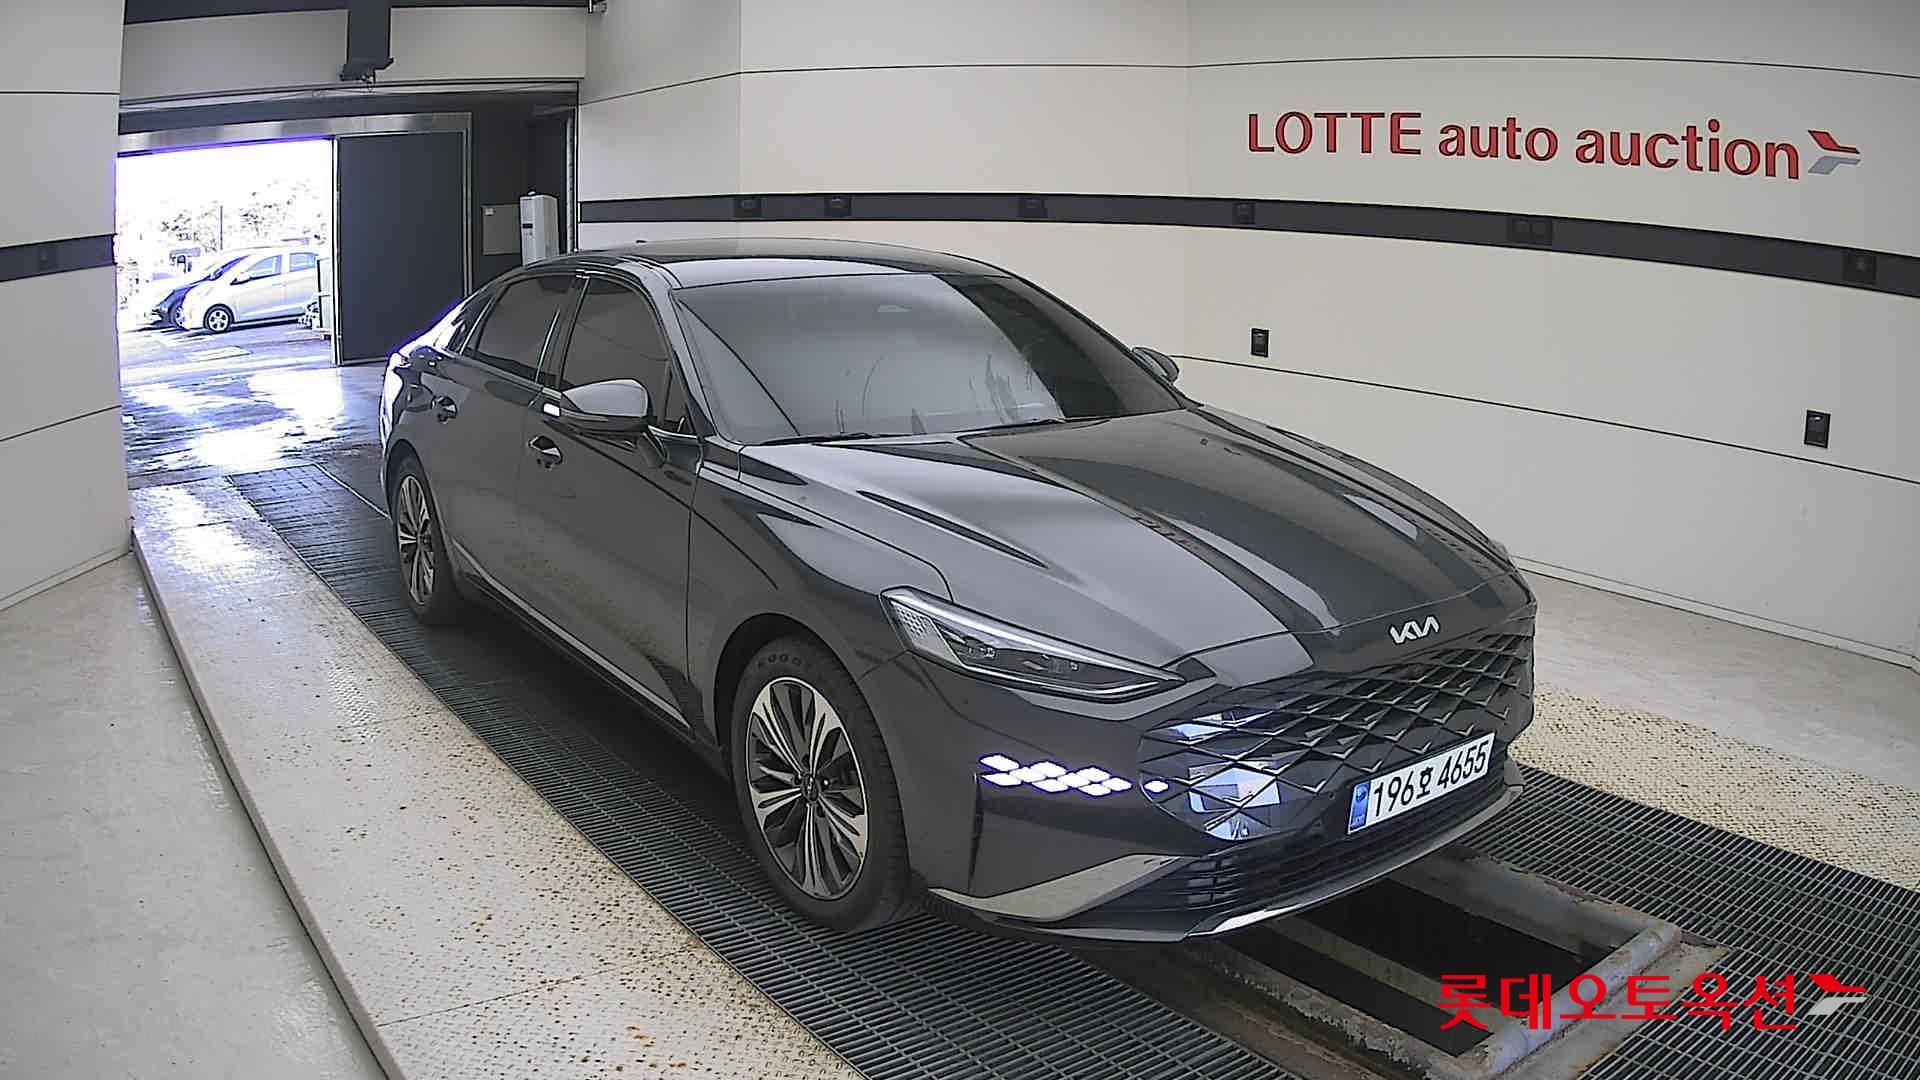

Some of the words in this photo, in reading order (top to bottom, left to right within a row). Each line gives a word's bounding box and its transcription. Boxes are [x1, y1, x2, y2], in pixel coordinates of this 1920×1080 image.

[1248, 111, 1422, 155] LOTTE
[1438, 117, 1559, 161] auto
[1575, 119, 1800, 179] auction
[1389, 616, 1440, 644] KIA
